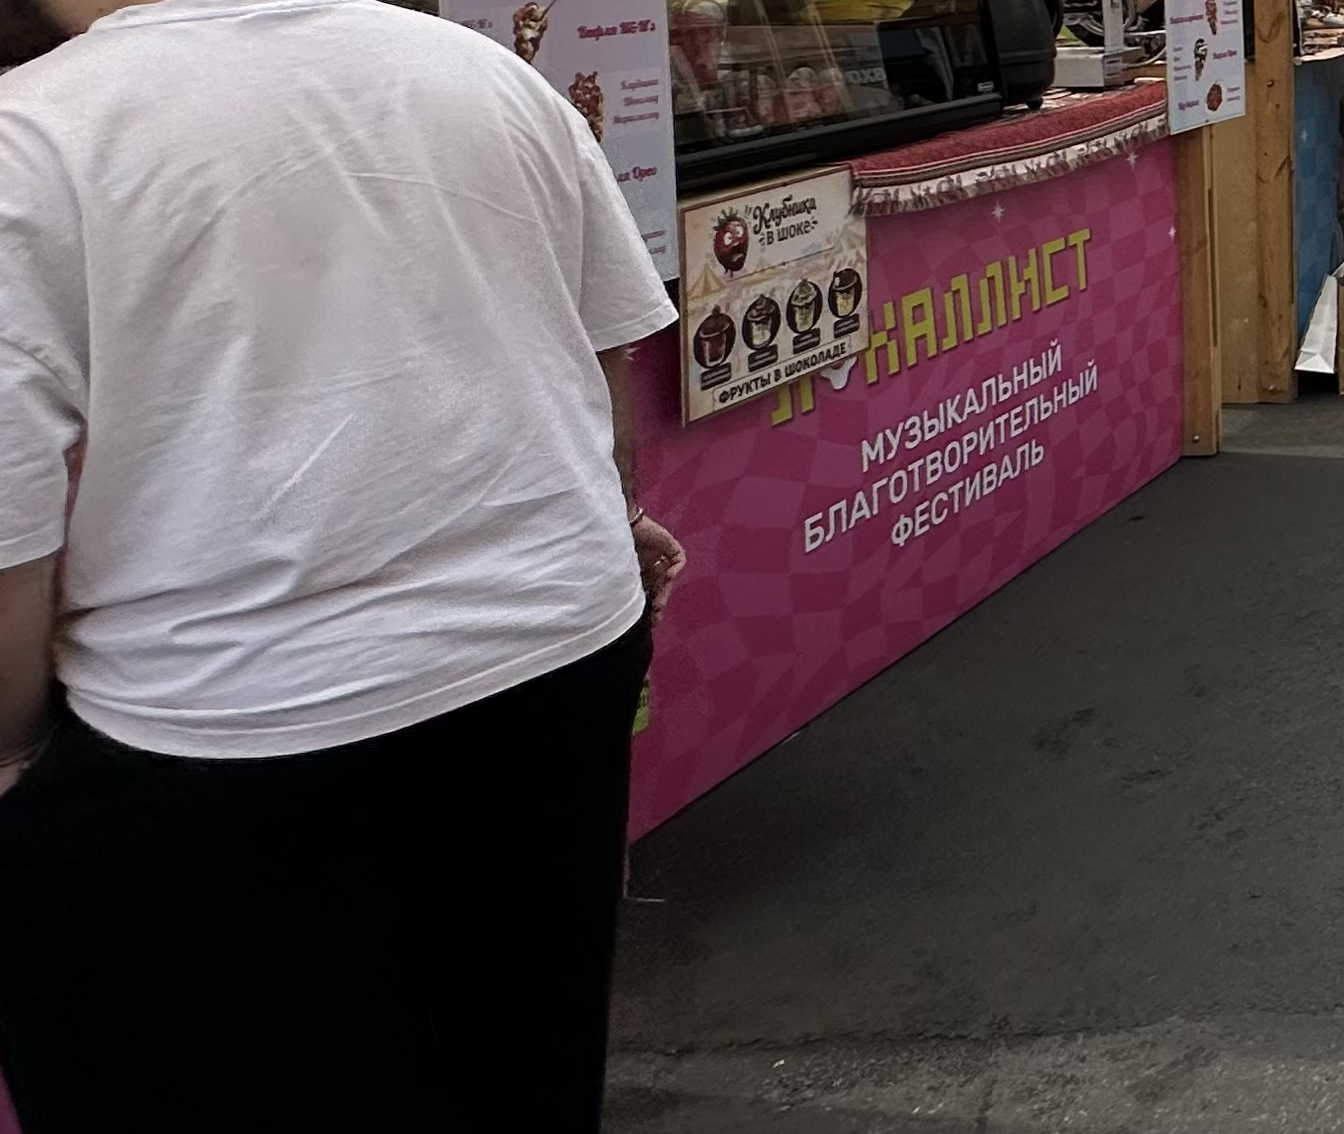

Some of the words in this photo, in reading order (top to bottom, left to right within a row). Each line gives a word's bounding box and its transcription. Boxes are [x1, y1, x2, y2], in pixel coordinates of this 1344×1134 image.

[718, 371, 771, 404] ФРУКТЫ
[784, 341, 847, 378] ШОКОЛАДЕ
[861, 338, 1063, 473] МУЗЫКАЛЬНЫЙ
[804, 358, 1098, 553] БЛАГОТВОРИТЕЛЬНЫЙ
[890, 438, 1044, 547] ФЕСТИВАЛЬ
